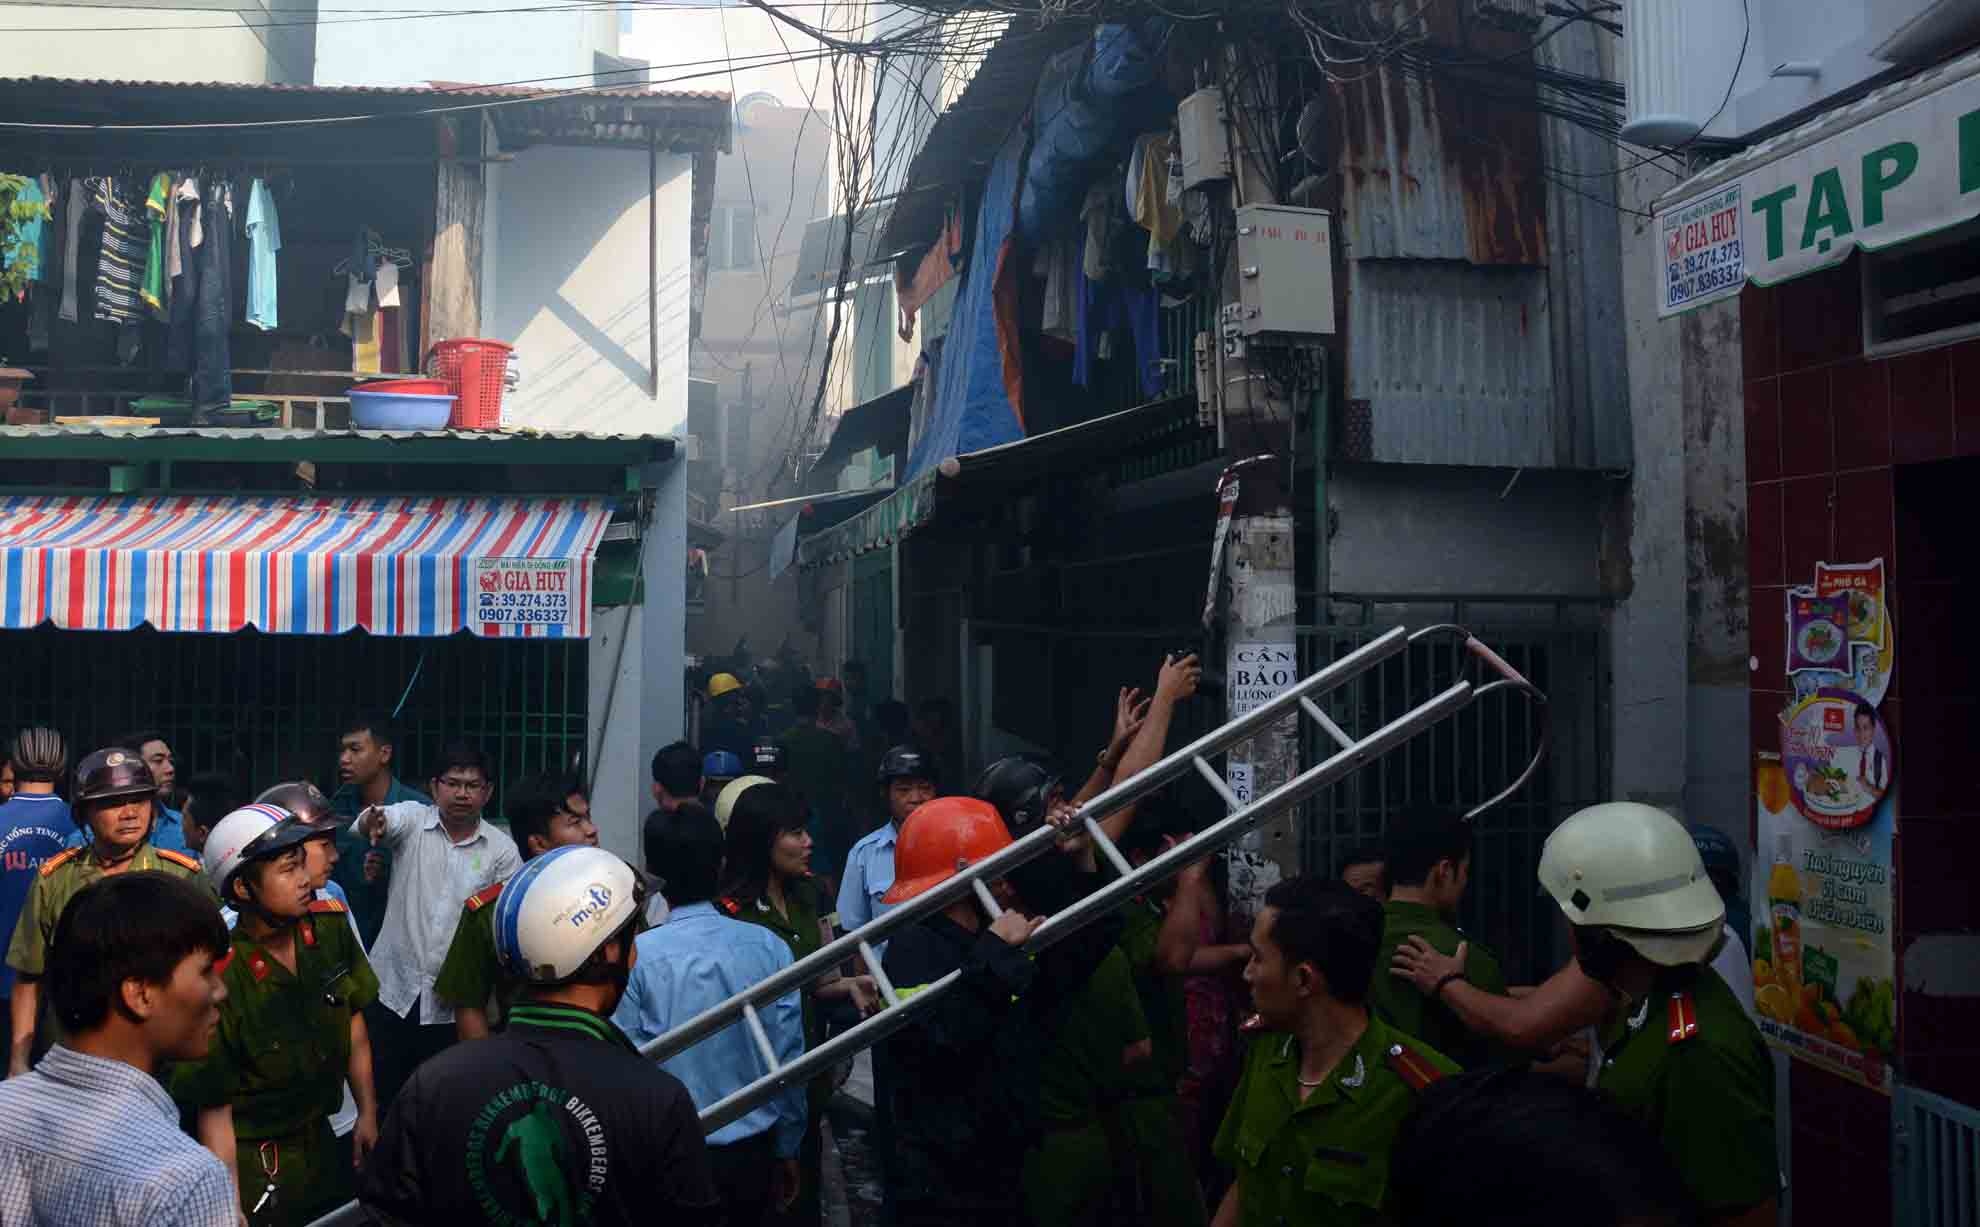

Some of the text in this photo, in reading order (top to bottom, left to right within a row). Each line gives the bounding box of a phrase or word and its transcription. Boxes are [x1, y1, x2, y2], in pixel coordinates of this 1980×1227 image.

[1752, 142, 1919, 261] TẠP
[1686, 207, 1737, 252] GIA HUY
[1670, 262, 1741, 301] 0907.836337
[505, 571, 567, 591] GIA HUY
[479, 608, 568, 622] 0907.836337
[1237, 665, 1288, 686] BẢO
